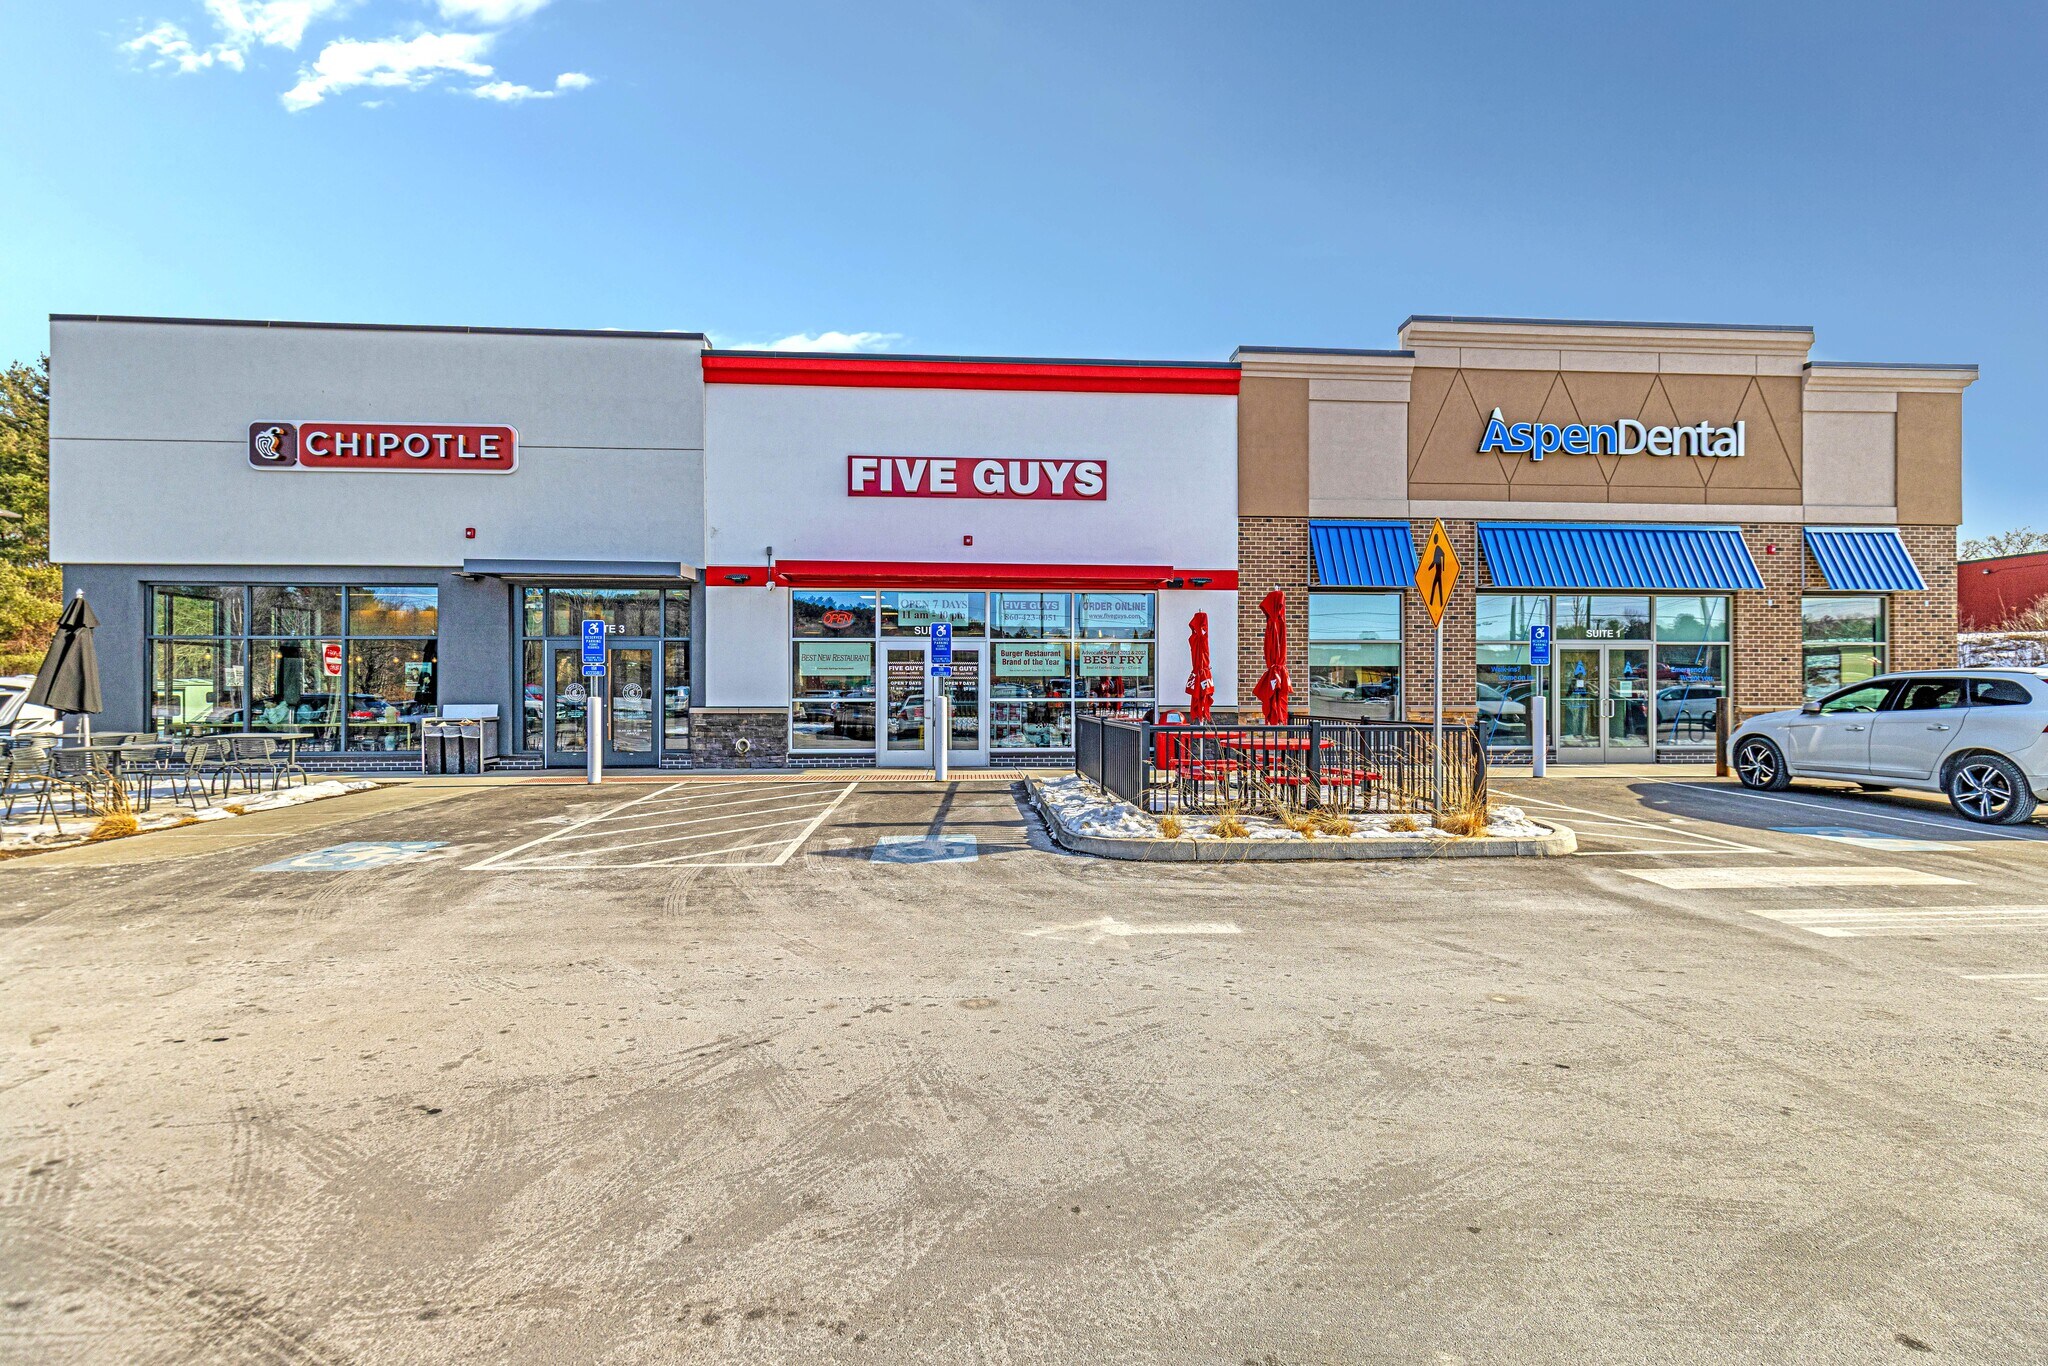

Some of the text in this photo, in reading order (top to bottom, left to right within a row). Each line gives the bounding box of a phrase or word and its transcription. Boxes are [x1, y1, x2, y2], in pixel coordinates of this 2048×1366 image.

[1480, 406, 1745, 461] AspenDental
[305, 431, 500, 459] CHIPOTLE
[851, 458, 1104, 496] FIVE GUYS
[901, 600, 968, 609] OPEN 7 DAYS
[1003, 601, 1058, 610] FIVE GUYS
[1083, 602, 1146, 611] ORDER ONLINE
[823, 611, 853, 624] OPEN
[901, 611, 911, 619] 11
[618, 625, 625, 633] 3
[801, 654, 870, 662] BEST NEW RESTAURANT
[1000, 650, 1023, 658] Burger
[1002, 658, 1060, 666] Brand of the Year
[1083, 655, 1145, 664] BEST FRY
